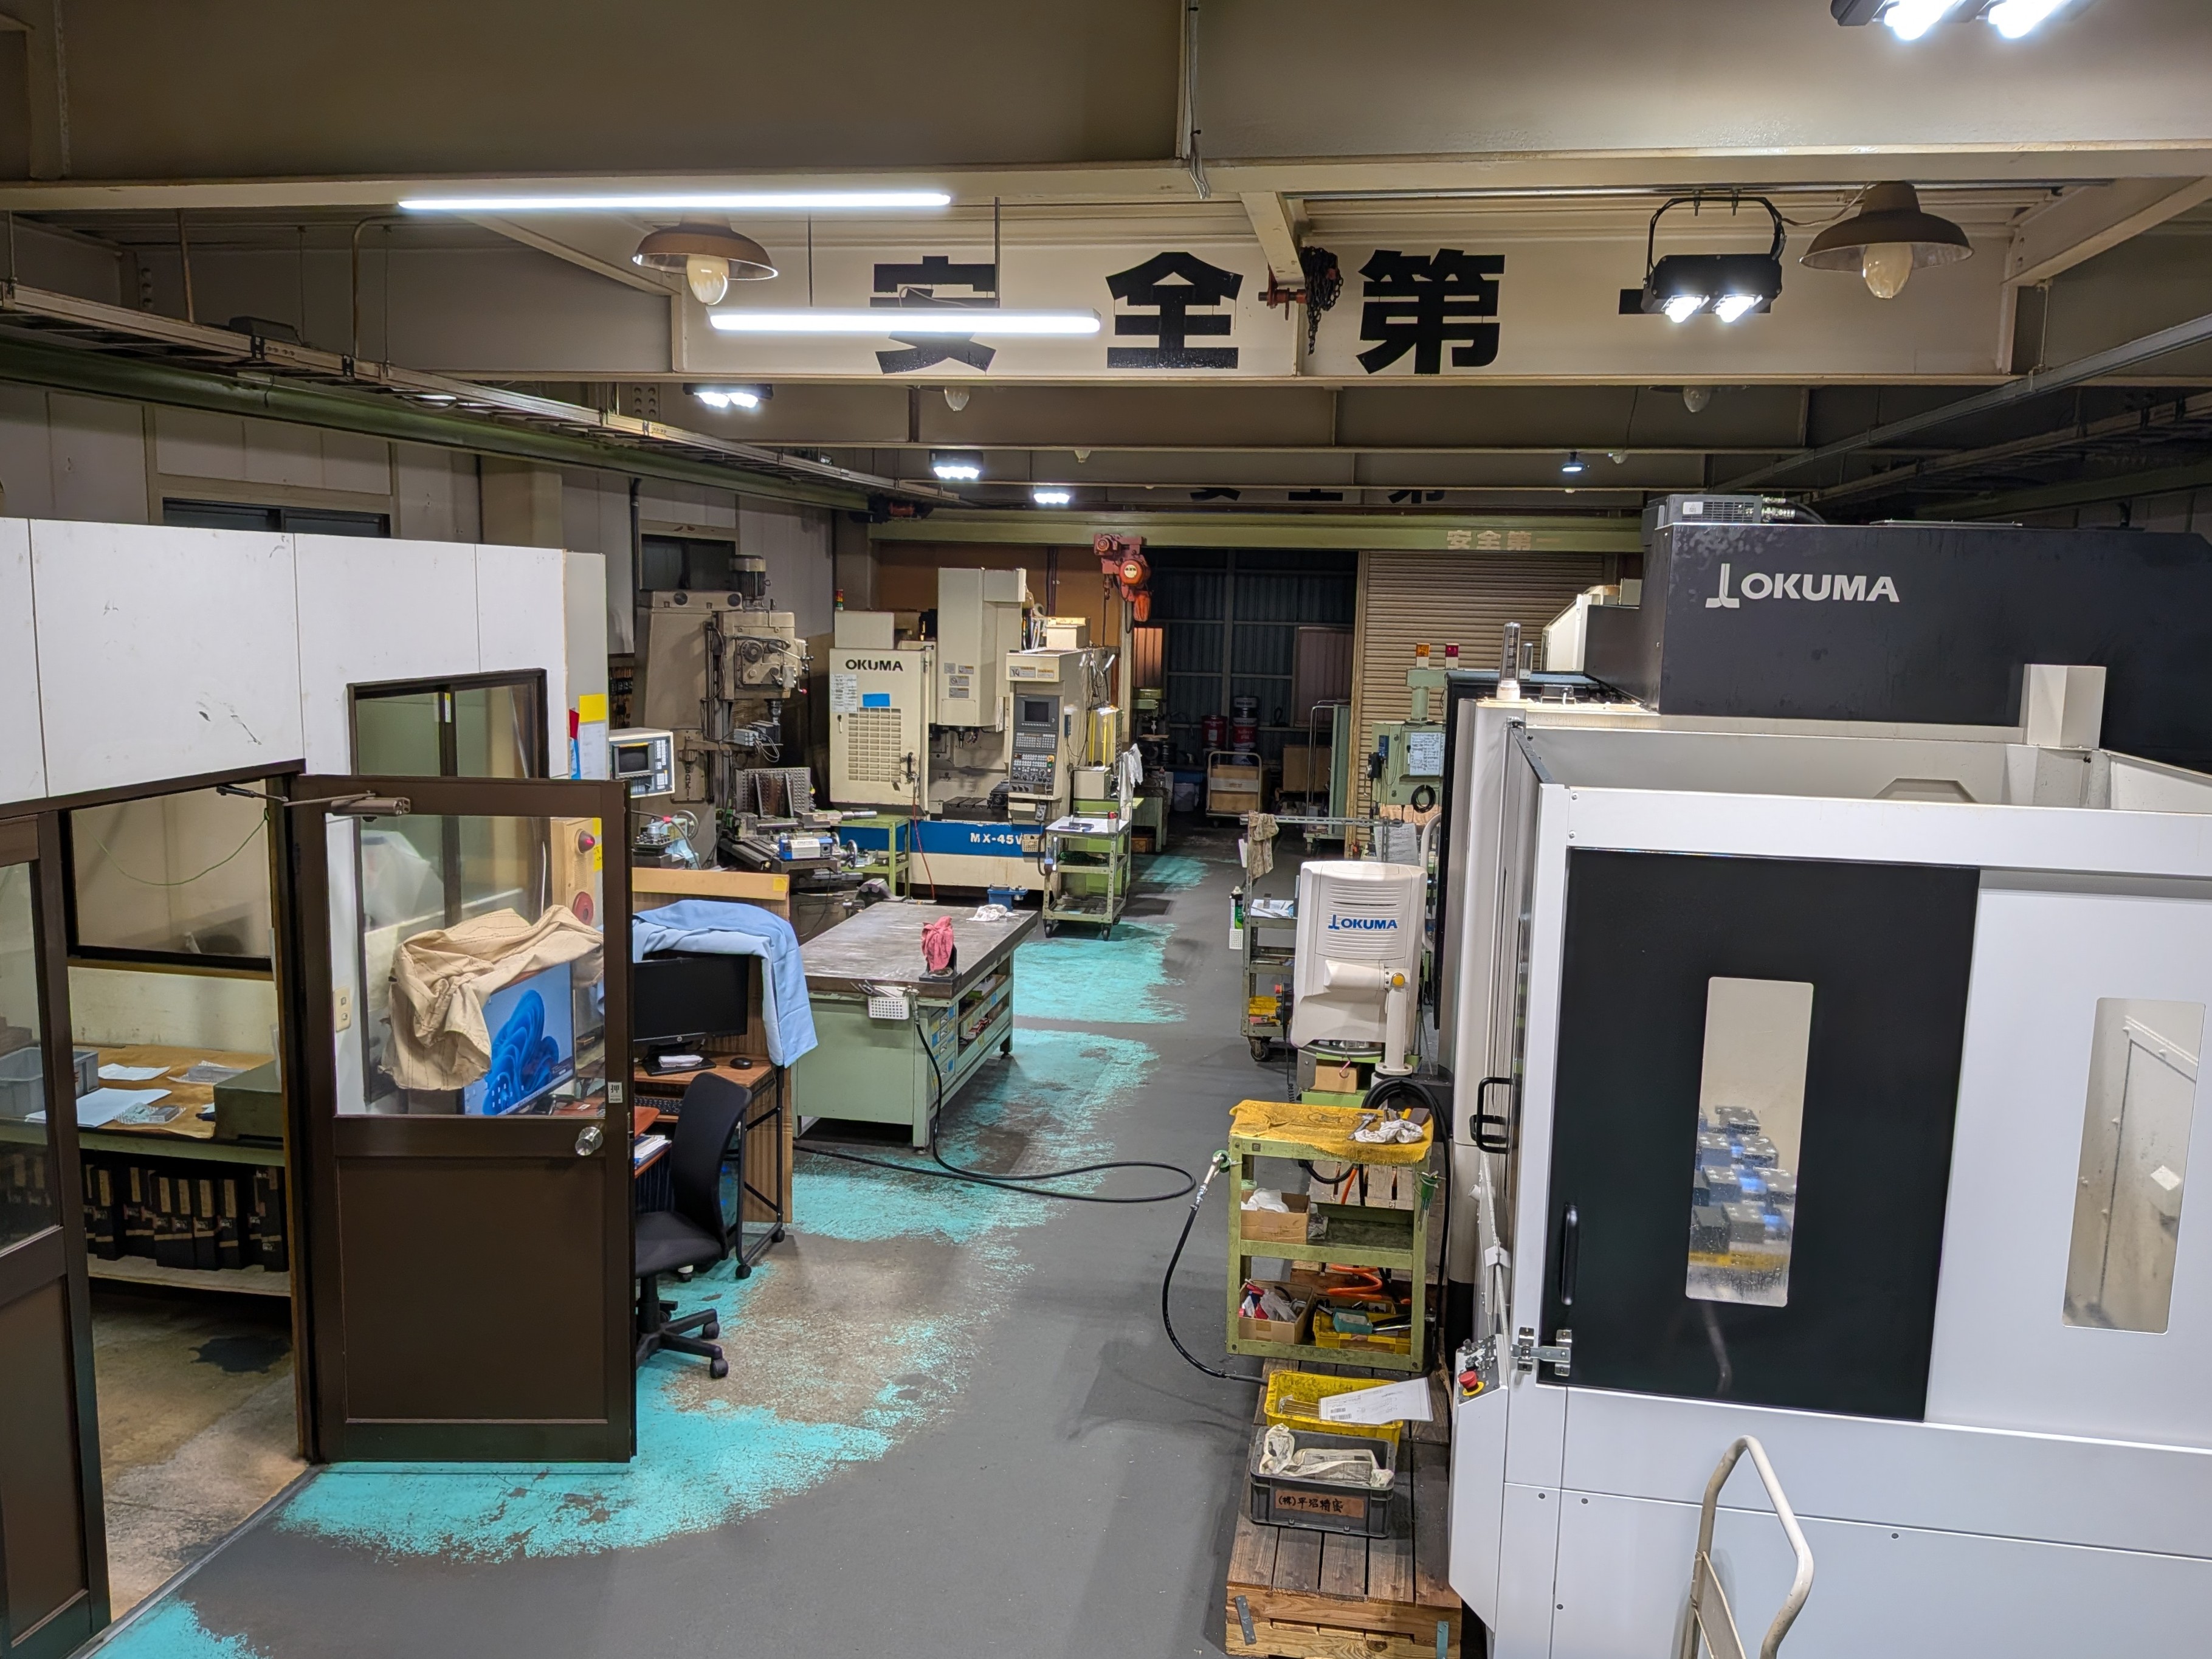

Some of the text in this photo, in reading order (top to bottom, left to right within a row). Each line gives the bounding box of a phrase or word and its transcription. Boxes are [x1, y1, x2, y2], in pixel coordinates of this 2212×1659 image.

[1447, 530, 1562, 550] 安全第一
[1741, 573, 1900, 602] OKUMA
[846, 659, 903, 671] OKUMA
[1341, 919, 1397, 930] OKUMA
